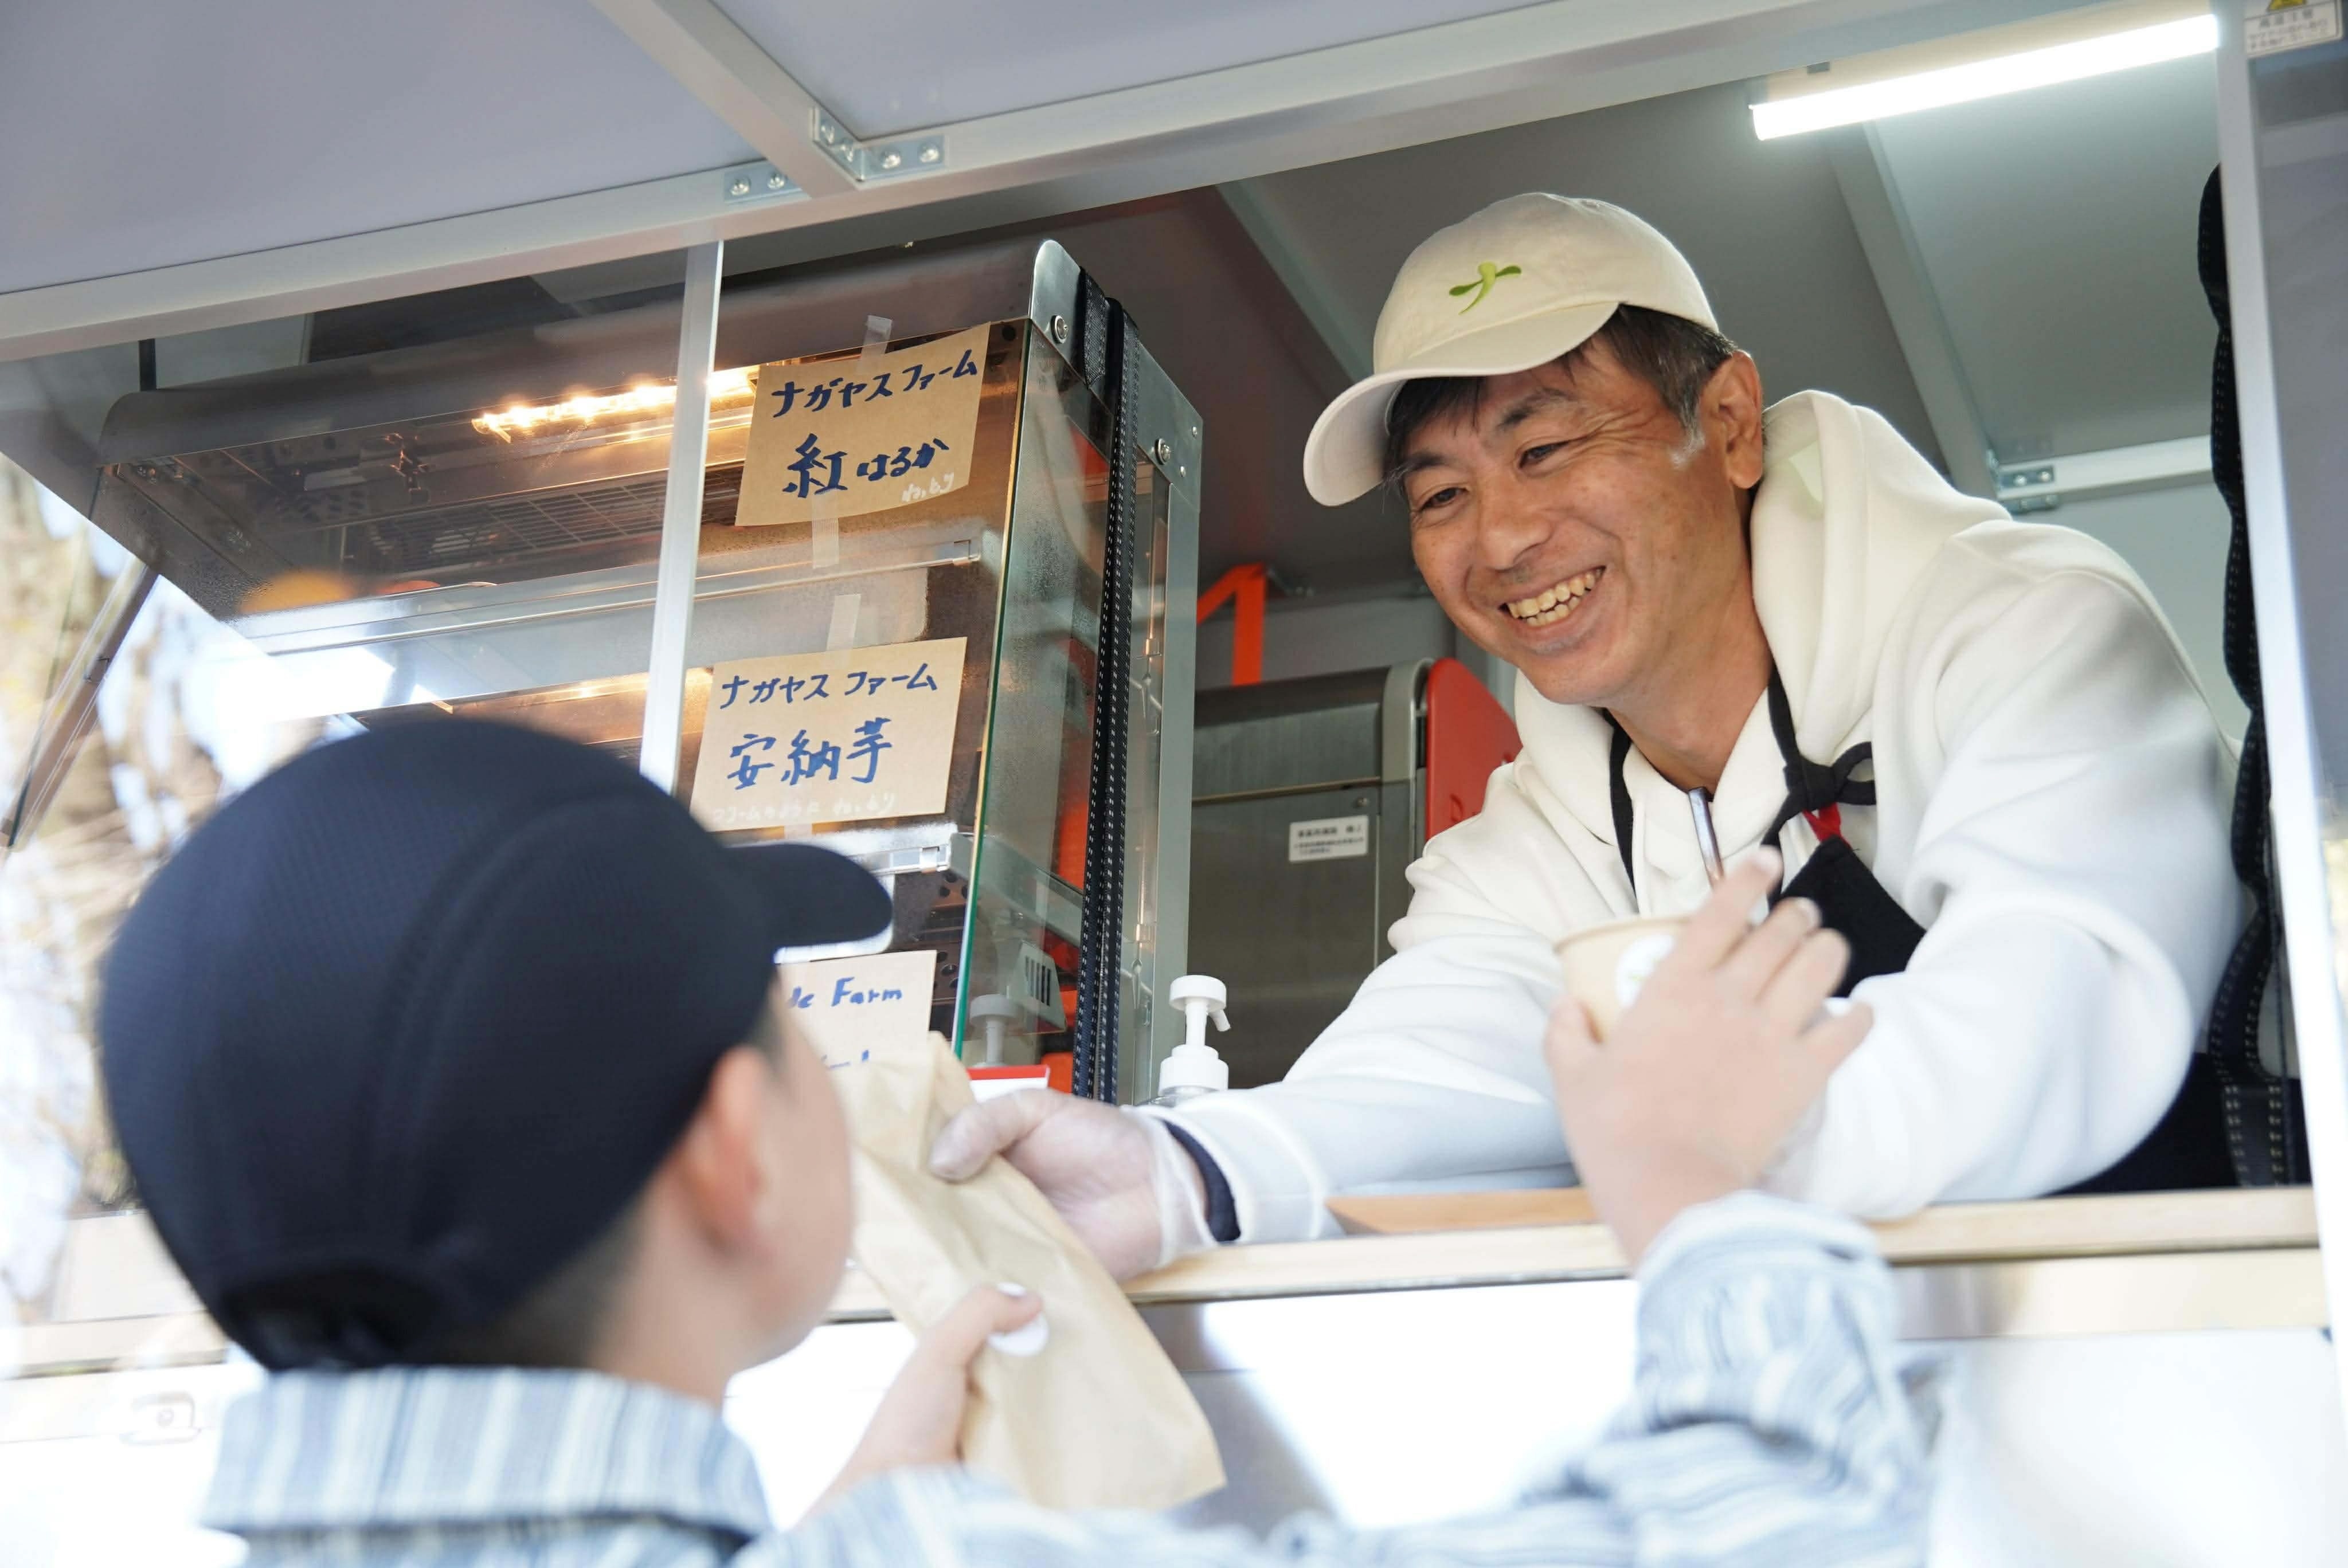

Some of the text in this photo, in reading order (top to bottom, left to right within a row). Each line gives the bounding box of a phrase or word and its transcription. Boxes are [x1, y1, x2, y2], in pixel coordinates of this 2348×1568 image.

[771, 348, 978, 418] ナガヤス ファーム
[783, 433, 950, 499] 紅はるか
[719, 663, 938, 709] ナガヤス ファーム
[726, 717, 893, 790] 安納芋
[830, 976, 905, 1008] Farm
